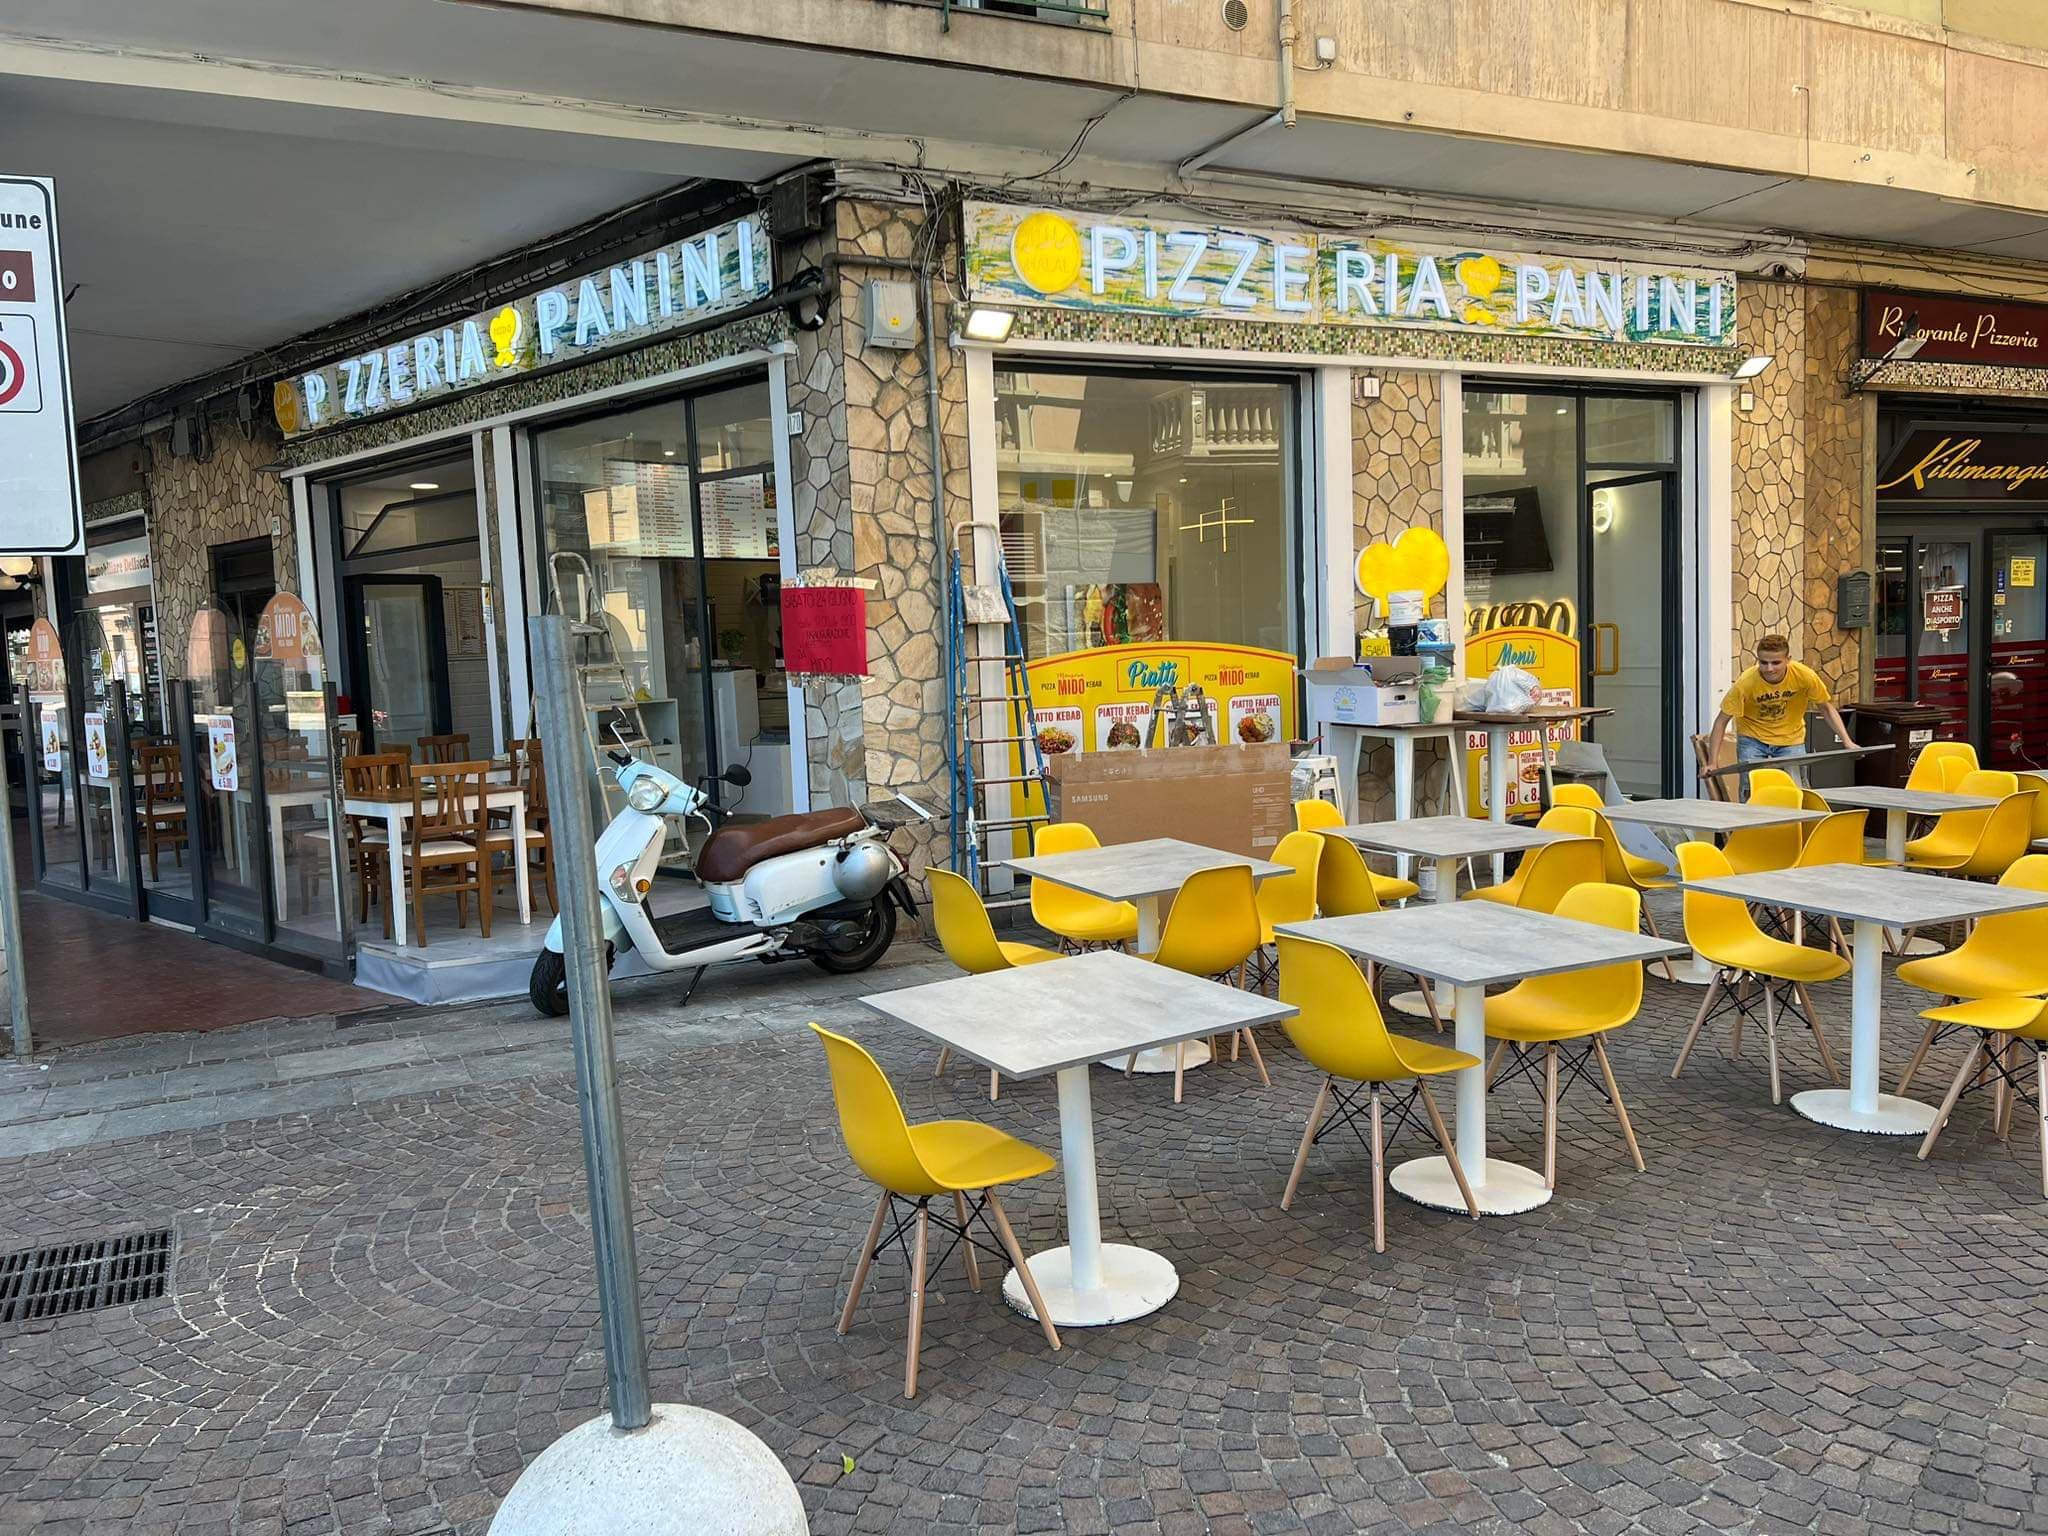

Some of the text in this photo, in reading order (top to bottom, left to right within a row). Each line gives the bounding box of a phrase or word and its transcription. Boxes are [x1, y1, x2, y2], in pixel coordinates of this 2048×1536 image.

[537, 221, 755, 354] PANINI
[1091, 226, 1722, 337] PIZZERIA PANINI
[1878, 306, 2040, 349] Riorante Pizzeria
[1933, 594, 1954, 602] PIZZA
[1931, 605, 1953, 613] ANCHE
[275, 613, 297, 638] MIDO
[1494, 642, 1537, 666] Menù
[1127, 660, 1178, 688] Piatti
[1219, 670, 1245, 686] MIDO
[1041, 678, 1102, 696] PIZZA MIDO KEBAB
[1231, 697, 1280, 709] PIATTO FALAFEL
[1056, 710, 1081, 721] KEBAB
[1098, 705, 1150, 718] PIATTO KEBAB
[1508, 730, 1532, 745] 8.00
[1548, 727, 1571, 741] 8.00
[1072, 794, 1109, 804] SAMSUNG
